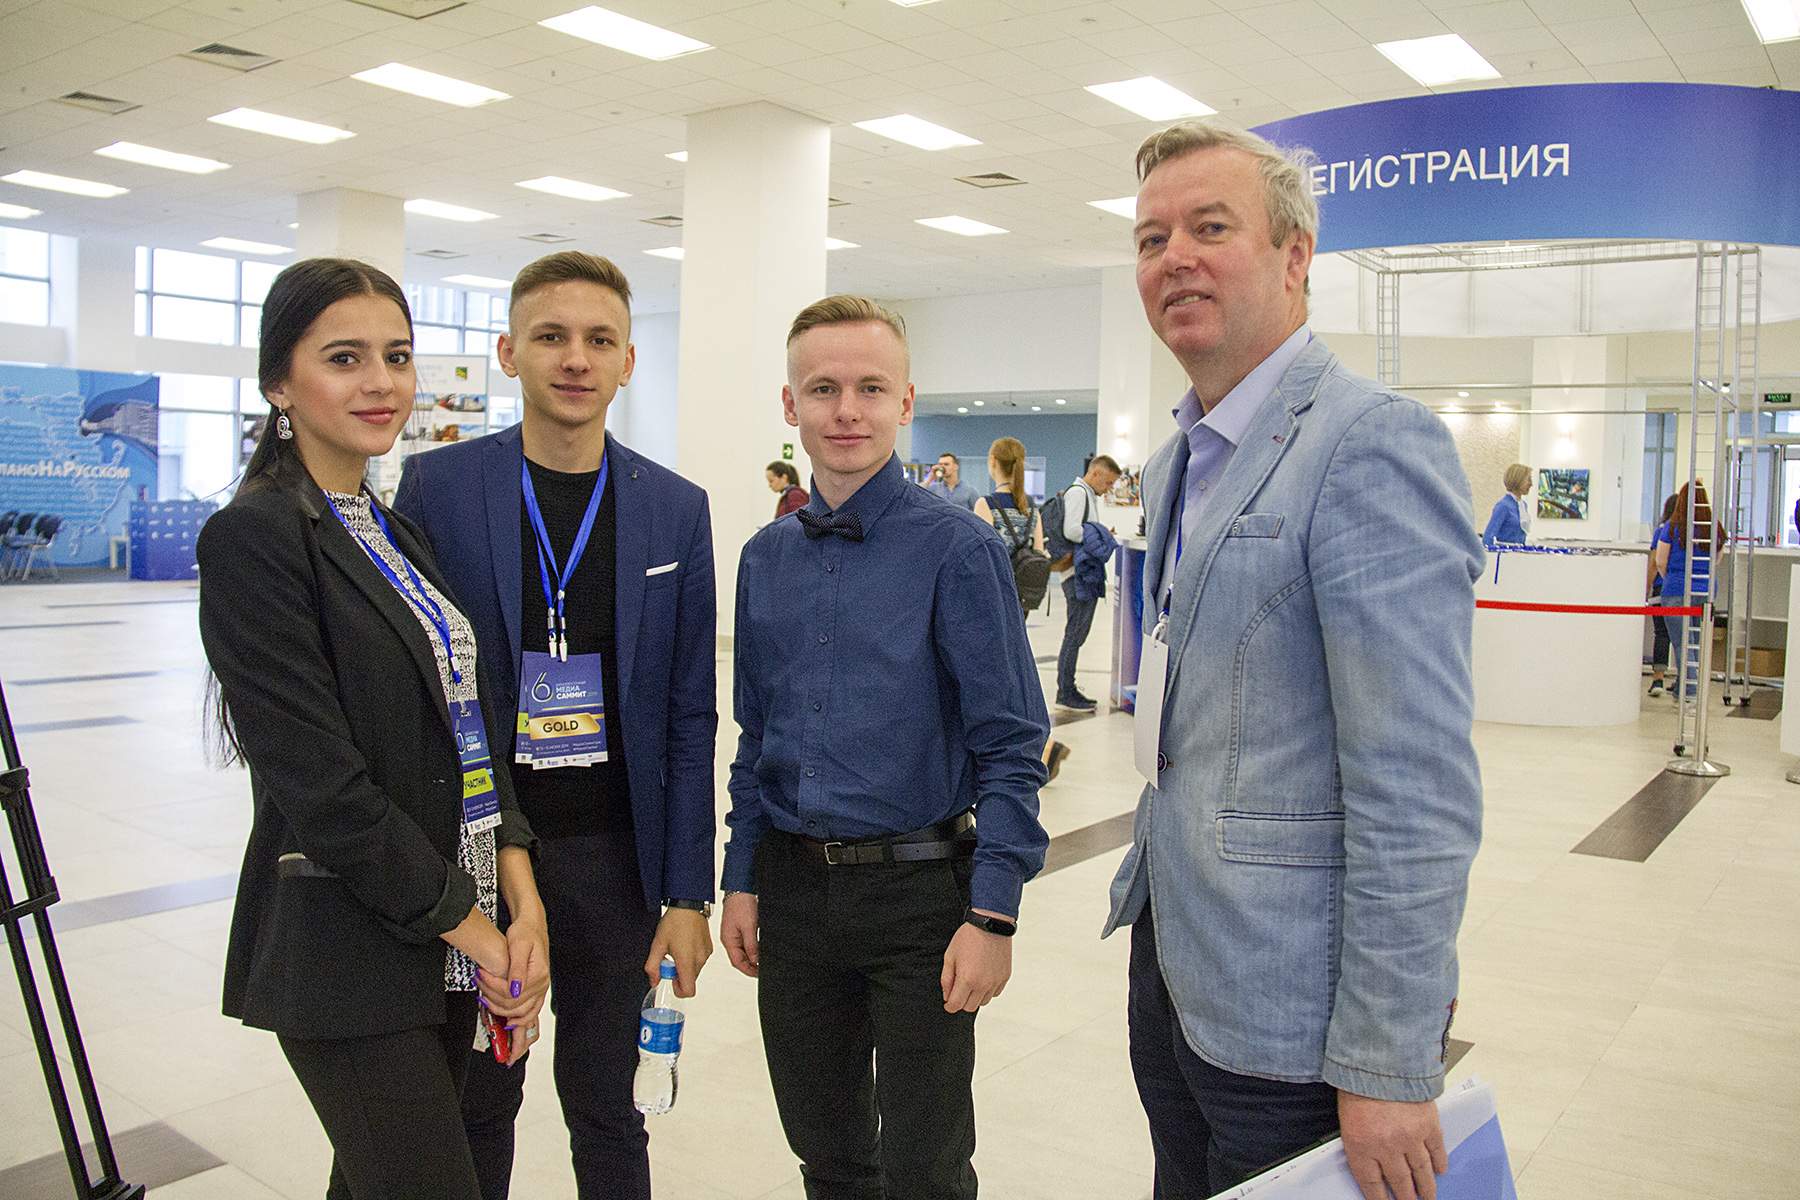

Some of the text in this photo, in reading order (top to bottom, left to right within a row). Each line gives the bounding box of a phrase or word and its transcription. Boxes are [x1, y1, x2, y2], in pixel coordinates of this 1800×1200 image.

[1308, 143, 1570, 196] ЕГИСТРАЦИЯ
[531, 671, 553, 703] 6
[556, 685, 580, 693] МЕДИА
[556, 690, 587, 700] САММИТ
[542, 720, 579, 733] GOLD
